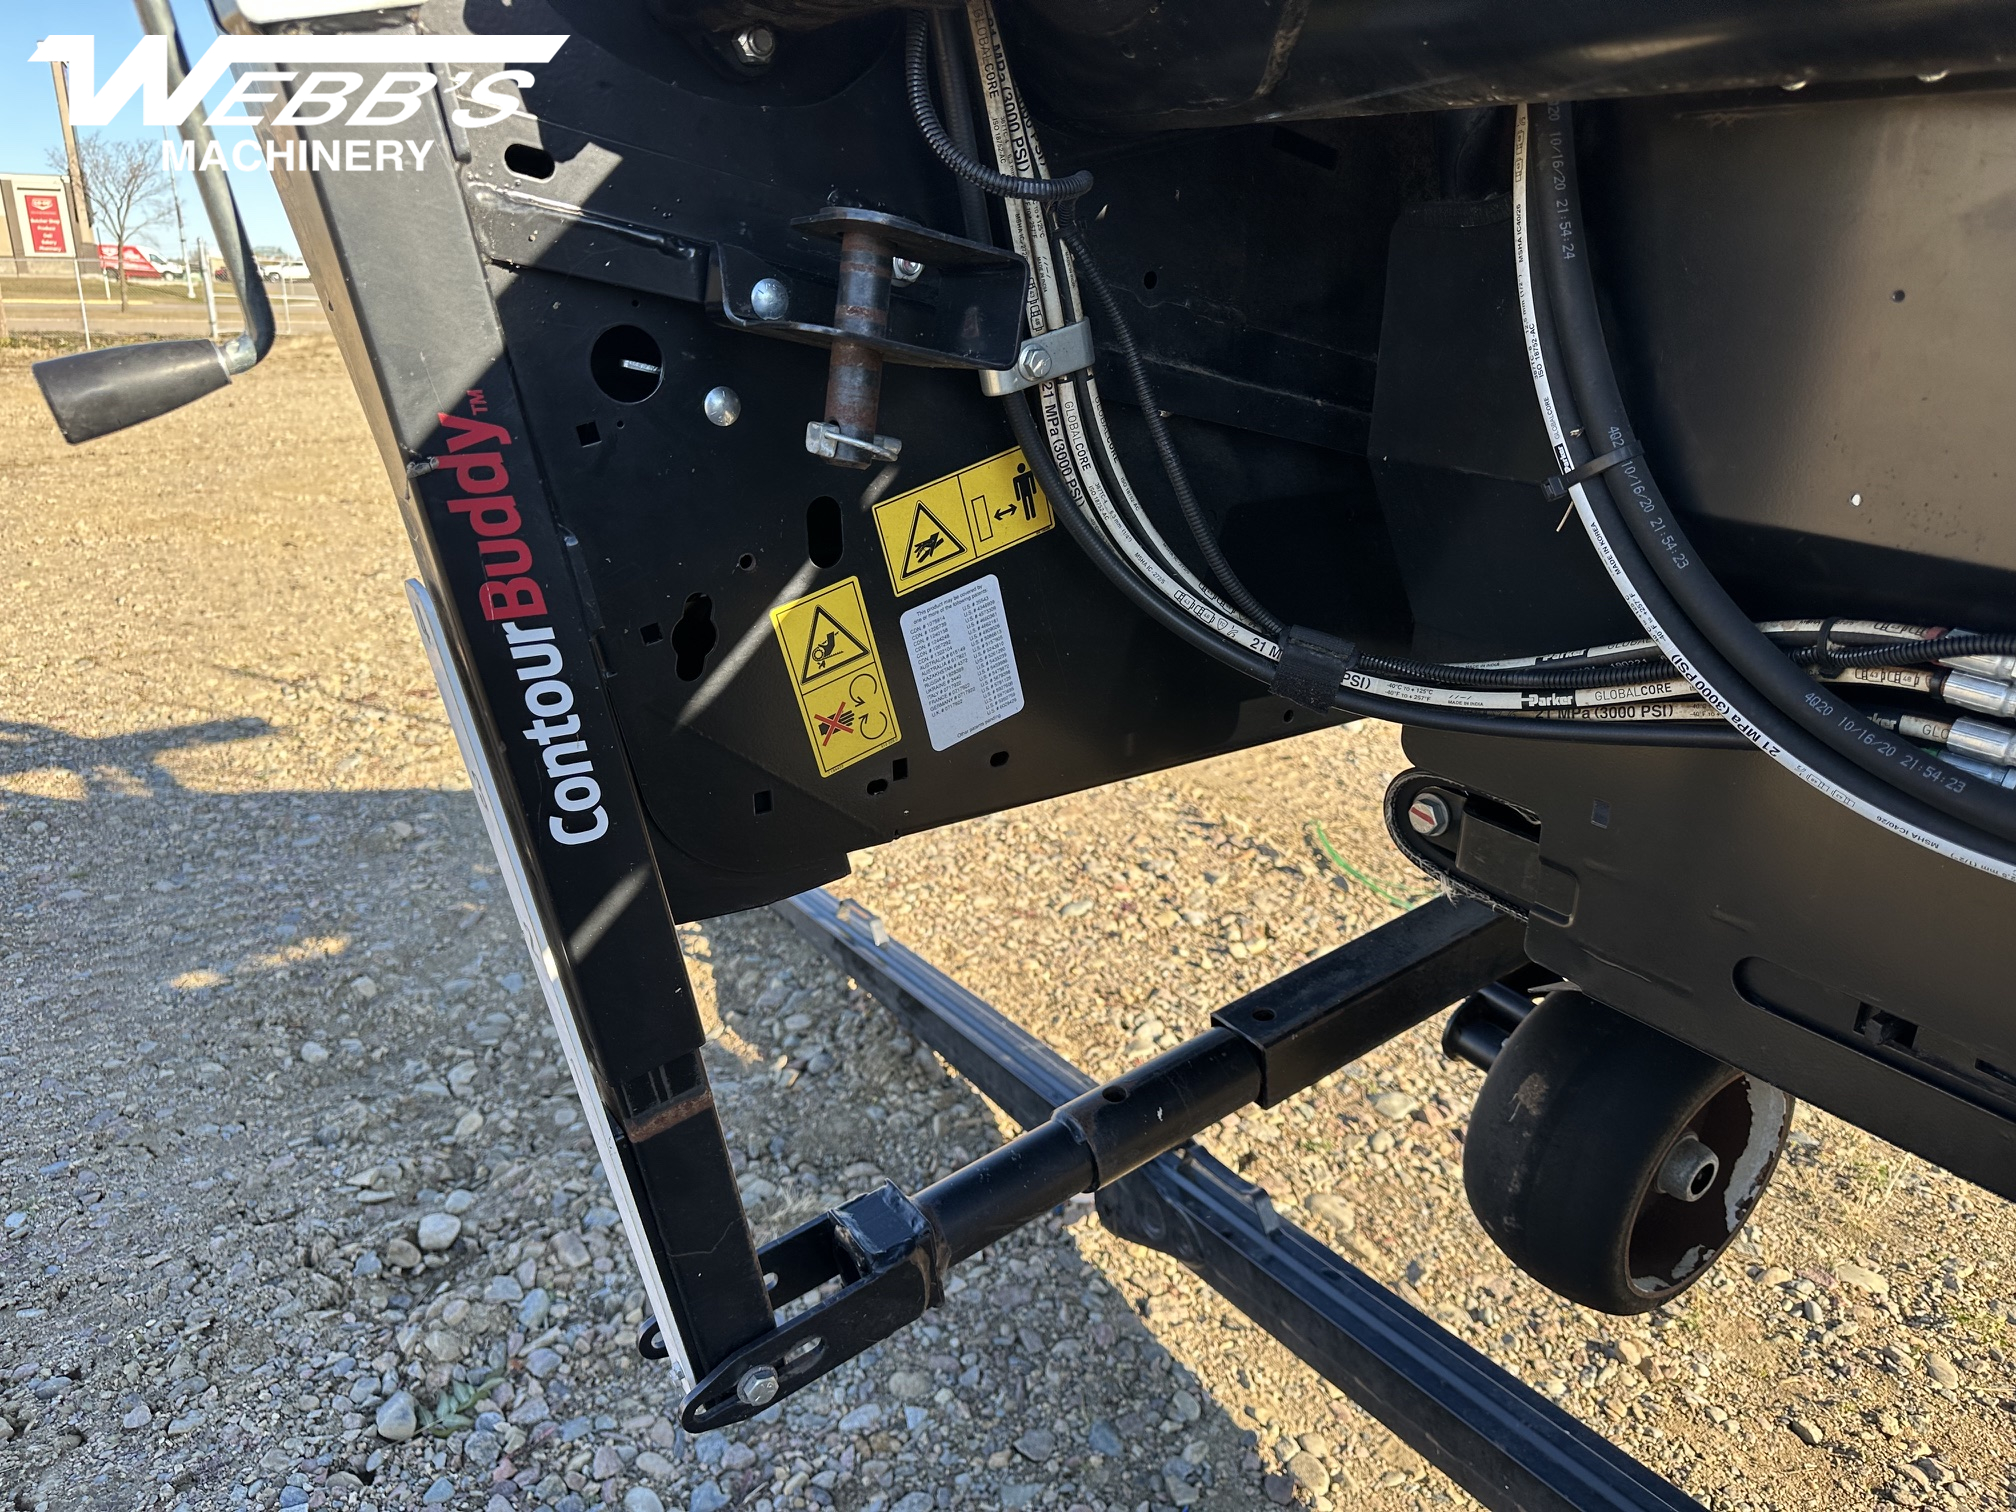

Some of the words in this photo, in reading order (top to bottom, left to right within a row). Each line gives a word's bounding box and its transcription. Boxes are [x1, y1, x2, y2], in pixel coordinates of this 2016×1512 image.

[973, 8, 999, 99] GLOBALCORE
[1548, 101, 1560, 122] 20
[1002, 85, 1020, 133] (3000
[1012, 137, 1031, 172] PSI)
[1549, 132, 1566, 191] 10/16/20
[1556, 199, 1575, 260] 21:54:24
[1529, 323, 1540, 360] 18752-AC
[1041, 382, 1055, 398] 21
[1045, 404, 1059, 436] MPa
[1543, 396, 1560, 440] GLOBALCORE
[1064, 401, 1091, 471] GLOBALCORE
[1052, 438, 1073, 477] (3000
[1557, 446, 1572, 474] Parker
[1065, 478, 1086, 507] PSI)
[1088, 485, 1096, 496] ISO
[1608, 426, 1624, 447] 4Q2
[1622, 461, 1654, 512] 10/16/20
[1650, 517, 1689, 569] 21:54:23
[1590, 522, 1607, 546] KOREA
[1134, 552, 1148, 567] MSHA
[1602, 545, 1610, 553] IN
[1607, 552, 1621, 575] MADE
[926, 602, 943, 613] product
[959, 587, 976, 597] covered
[952, 596, 971, 607] following
[1250, 637, 1267, 652] 21
[1542, 648, 1587, 661] Parker
[1607, 638, 1653, 650] GLOBAL
[1671, 654, 1697, 682] PSI)
[1342, 672, 1371, 690] PSI)
[1528, 693, 1573, 707] Parker
[1595, 683, 1672, 701] GLOBALCORE
[1695, 681, 1730, 714] (3000
[1560, 709, 1590, 719] MPa
[1594, 706, 1635, 719] (3000
[1641, 704, 1674, 718] PSI)
[1867, 712, 1897, 730] ker
[1732, 714, 1761, 742] MPa
[1762, 741, 1780, 757] 21
[1805, 692, 1834, 716] 4Q20
[1838, 716, 1896, 757] 10/16/20
[1900, 755, 1966, 793] 21:54:23
[1876, 815, 1909, 835] IC40/26
[1910, 832, 1939, 849] MSHA
